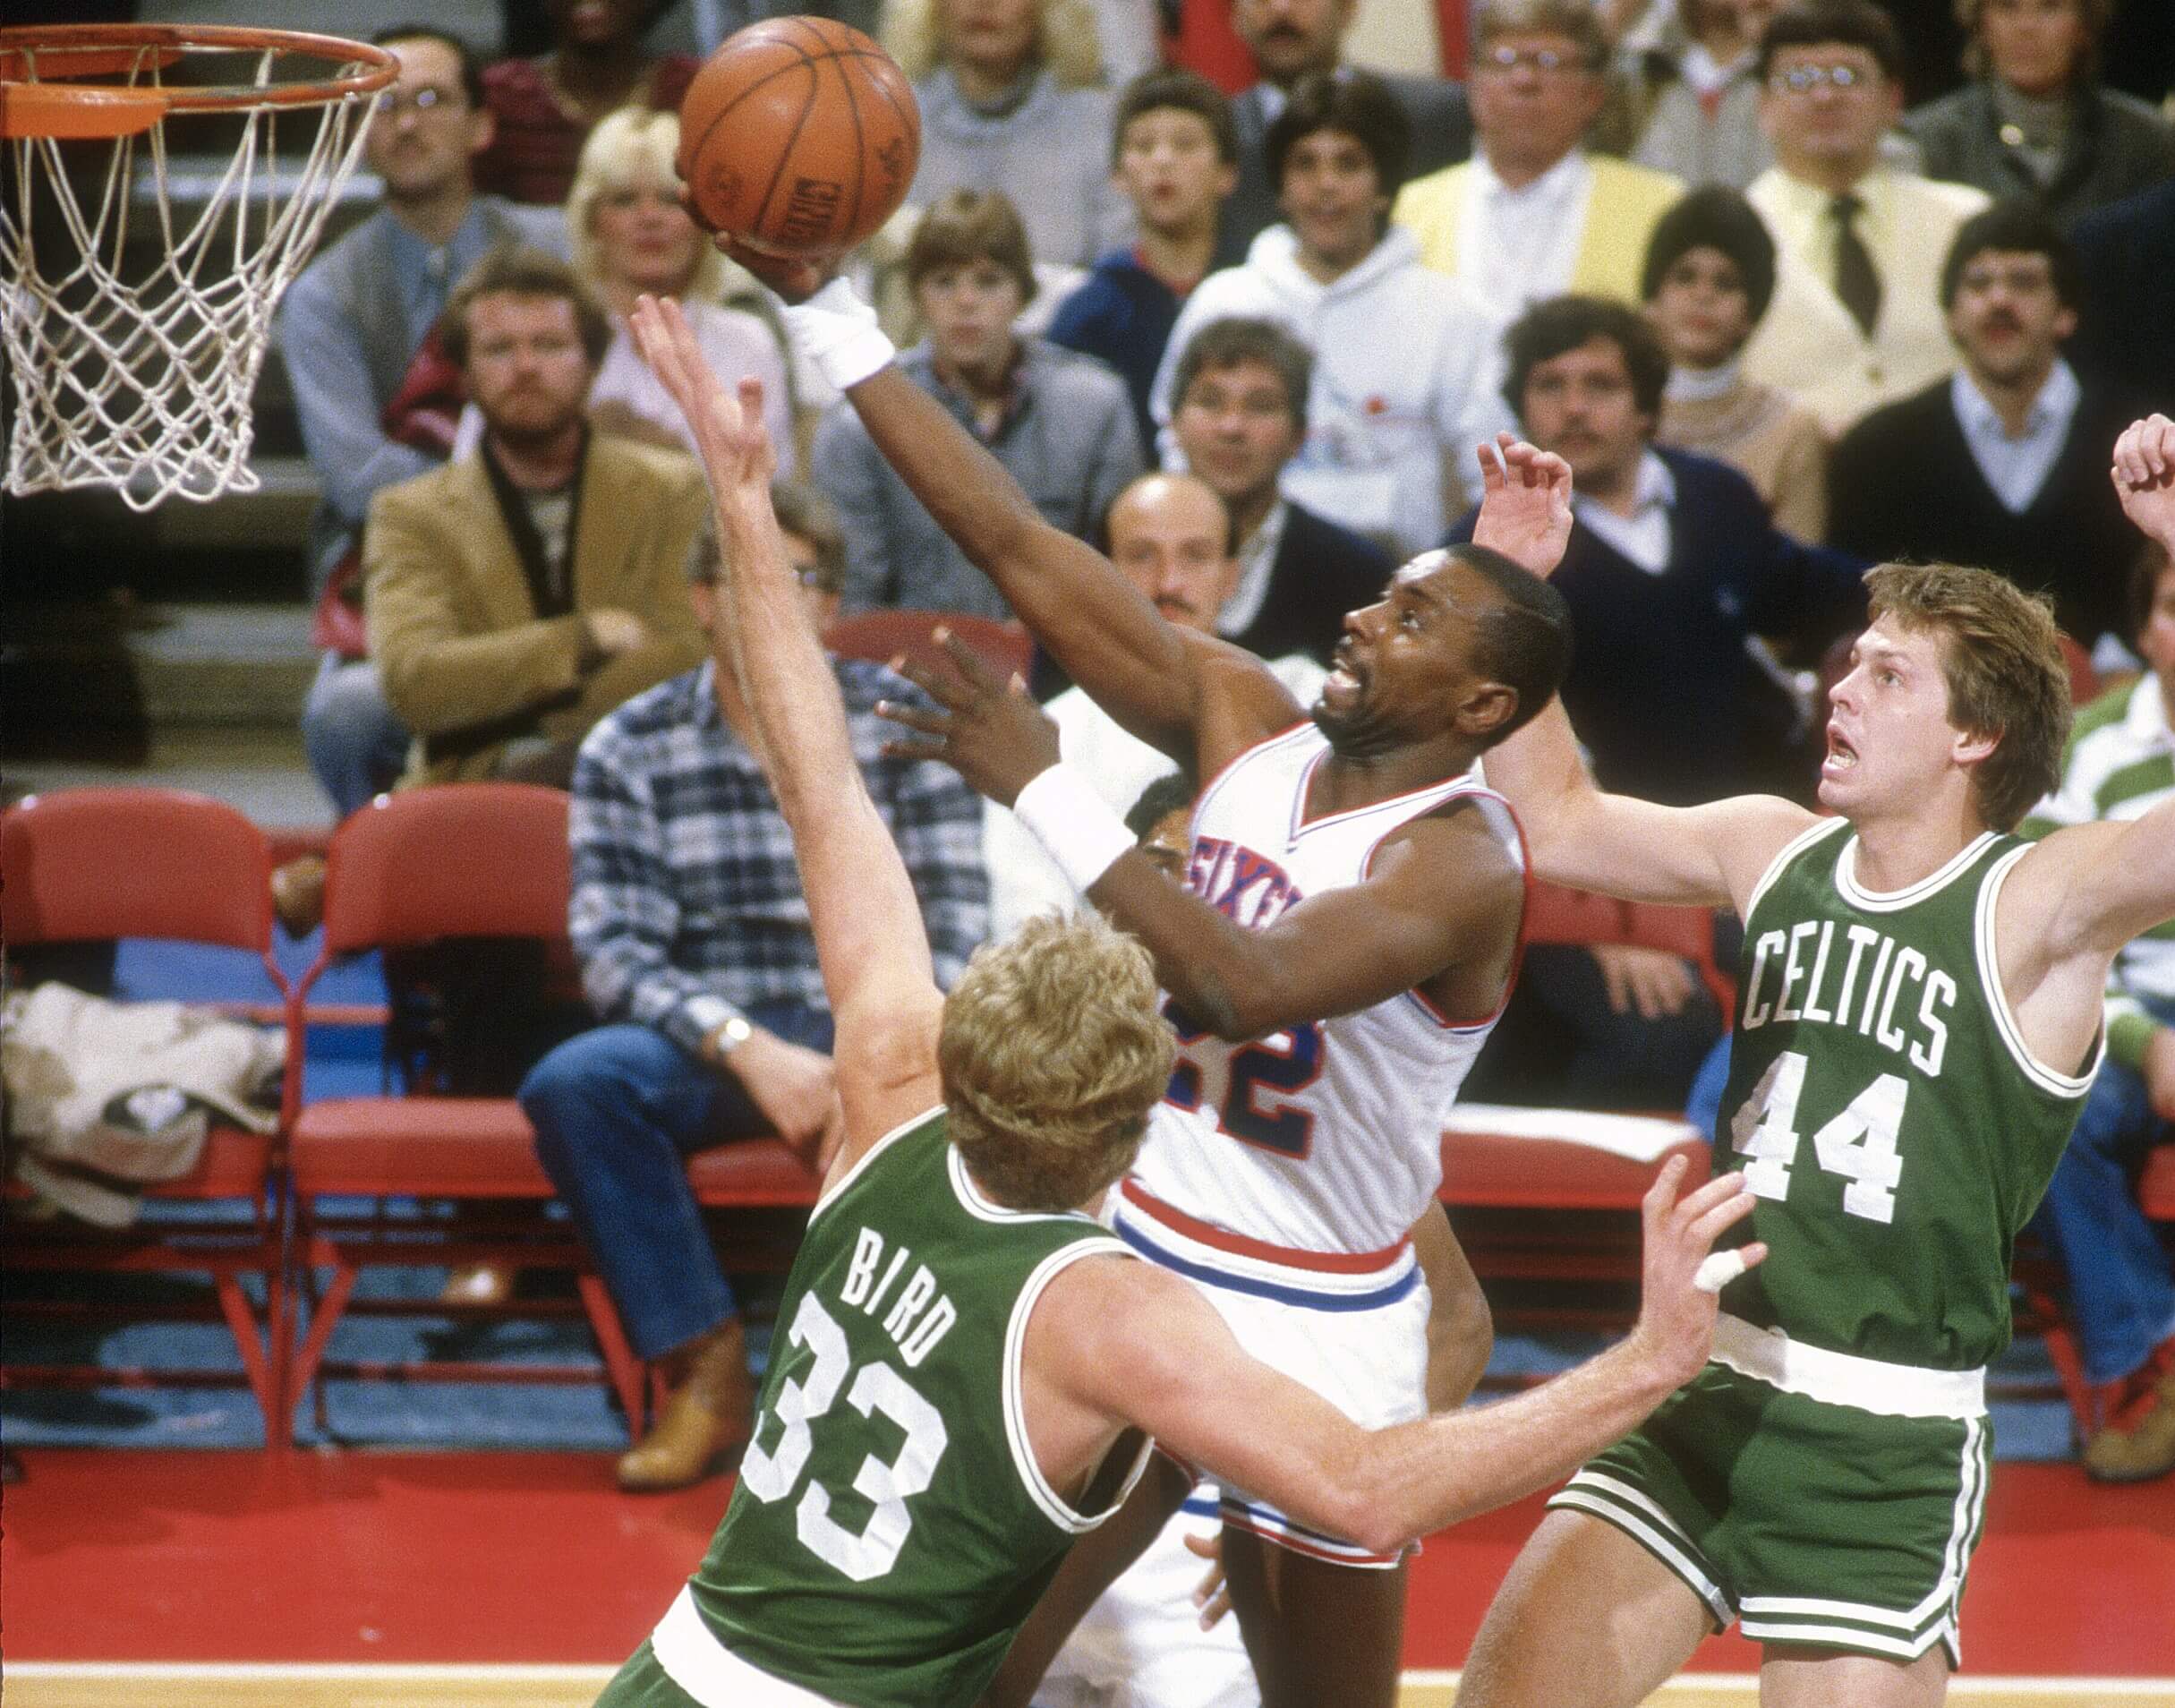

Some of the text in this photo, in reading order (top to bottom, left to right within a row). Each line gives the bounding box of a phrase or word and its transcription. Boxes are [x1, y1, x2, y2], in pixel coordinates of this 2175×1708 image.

[1742, 920, 1957, 1078] CELTICS
[1731, 1050, 1909, 1225] 44
[840, 1225, 958, 1369] BIRD
[739, 1290, 949, 1583] 33
